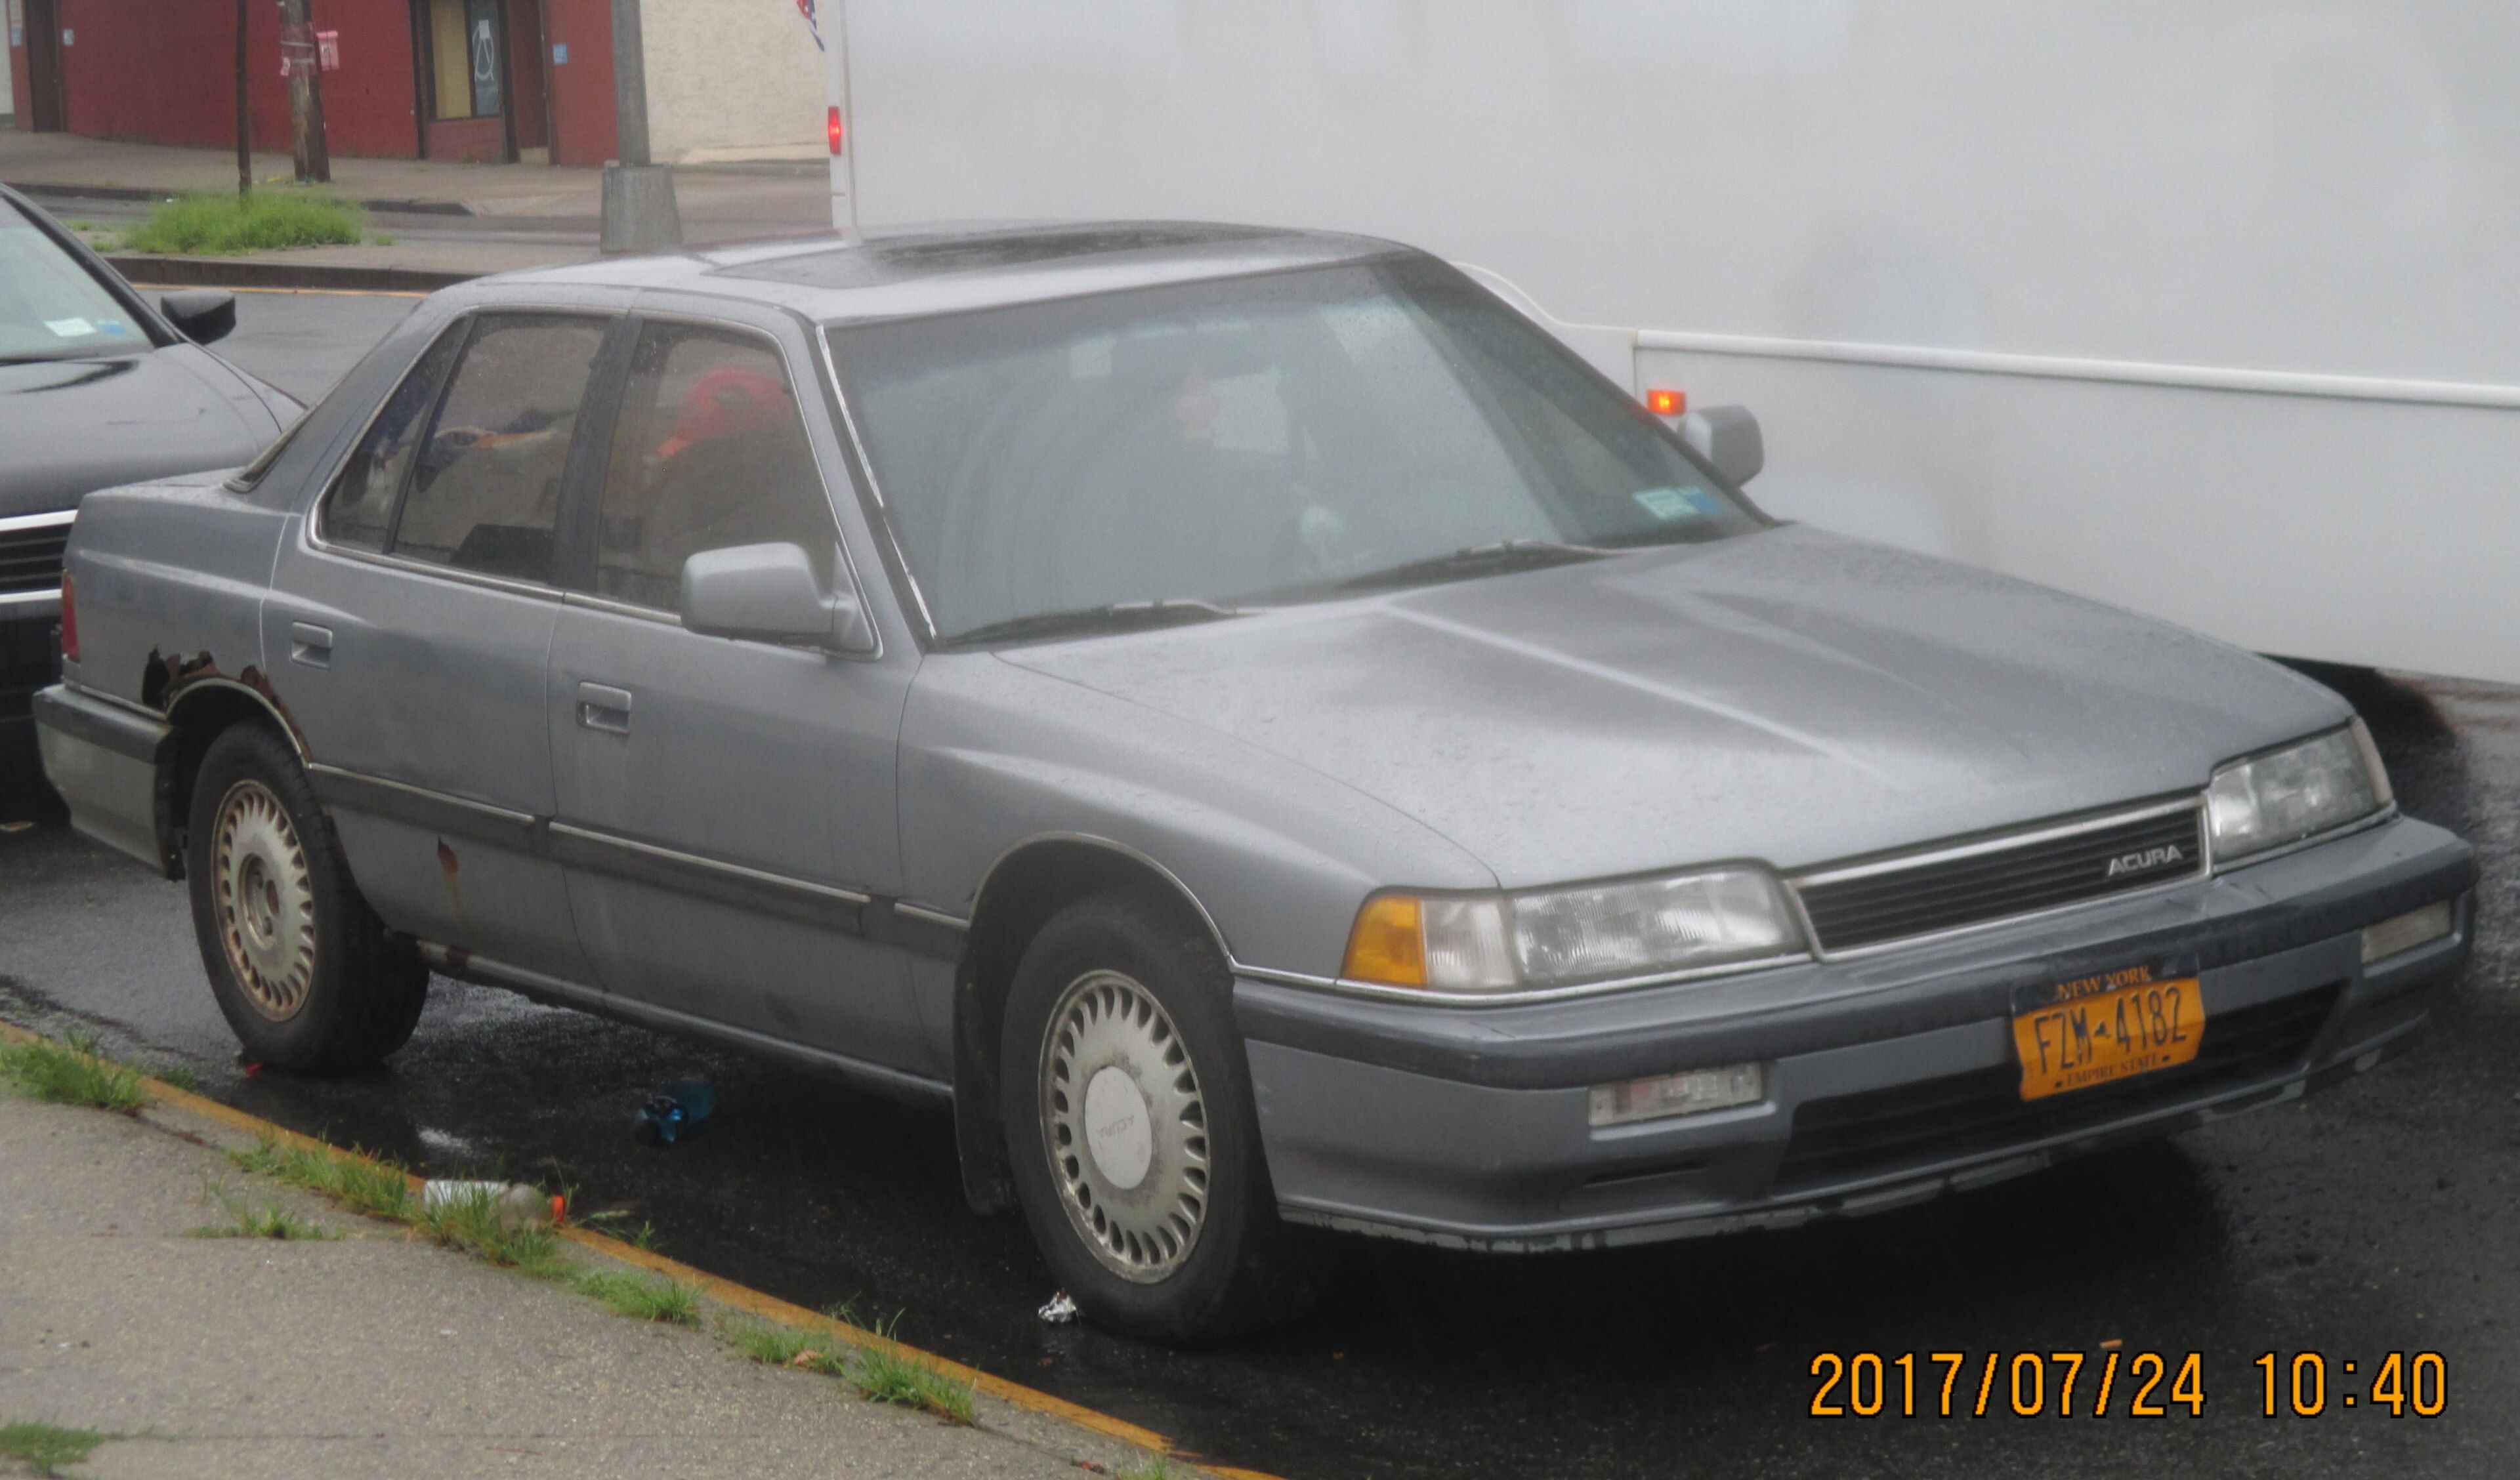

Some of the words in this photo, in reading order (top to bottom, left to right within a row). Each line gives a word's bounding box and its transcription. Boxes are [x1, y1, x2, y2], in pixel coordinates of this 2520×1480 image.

[2108, 844, 2183, 876] ACURA
[2058, 977, 2100, 998] NEW
[2107, 966, 2151, 989] YORK
[2067, 1065, 2114, 1086] EMPIRE
[2120, 1054, 2156, 1072] STATE
